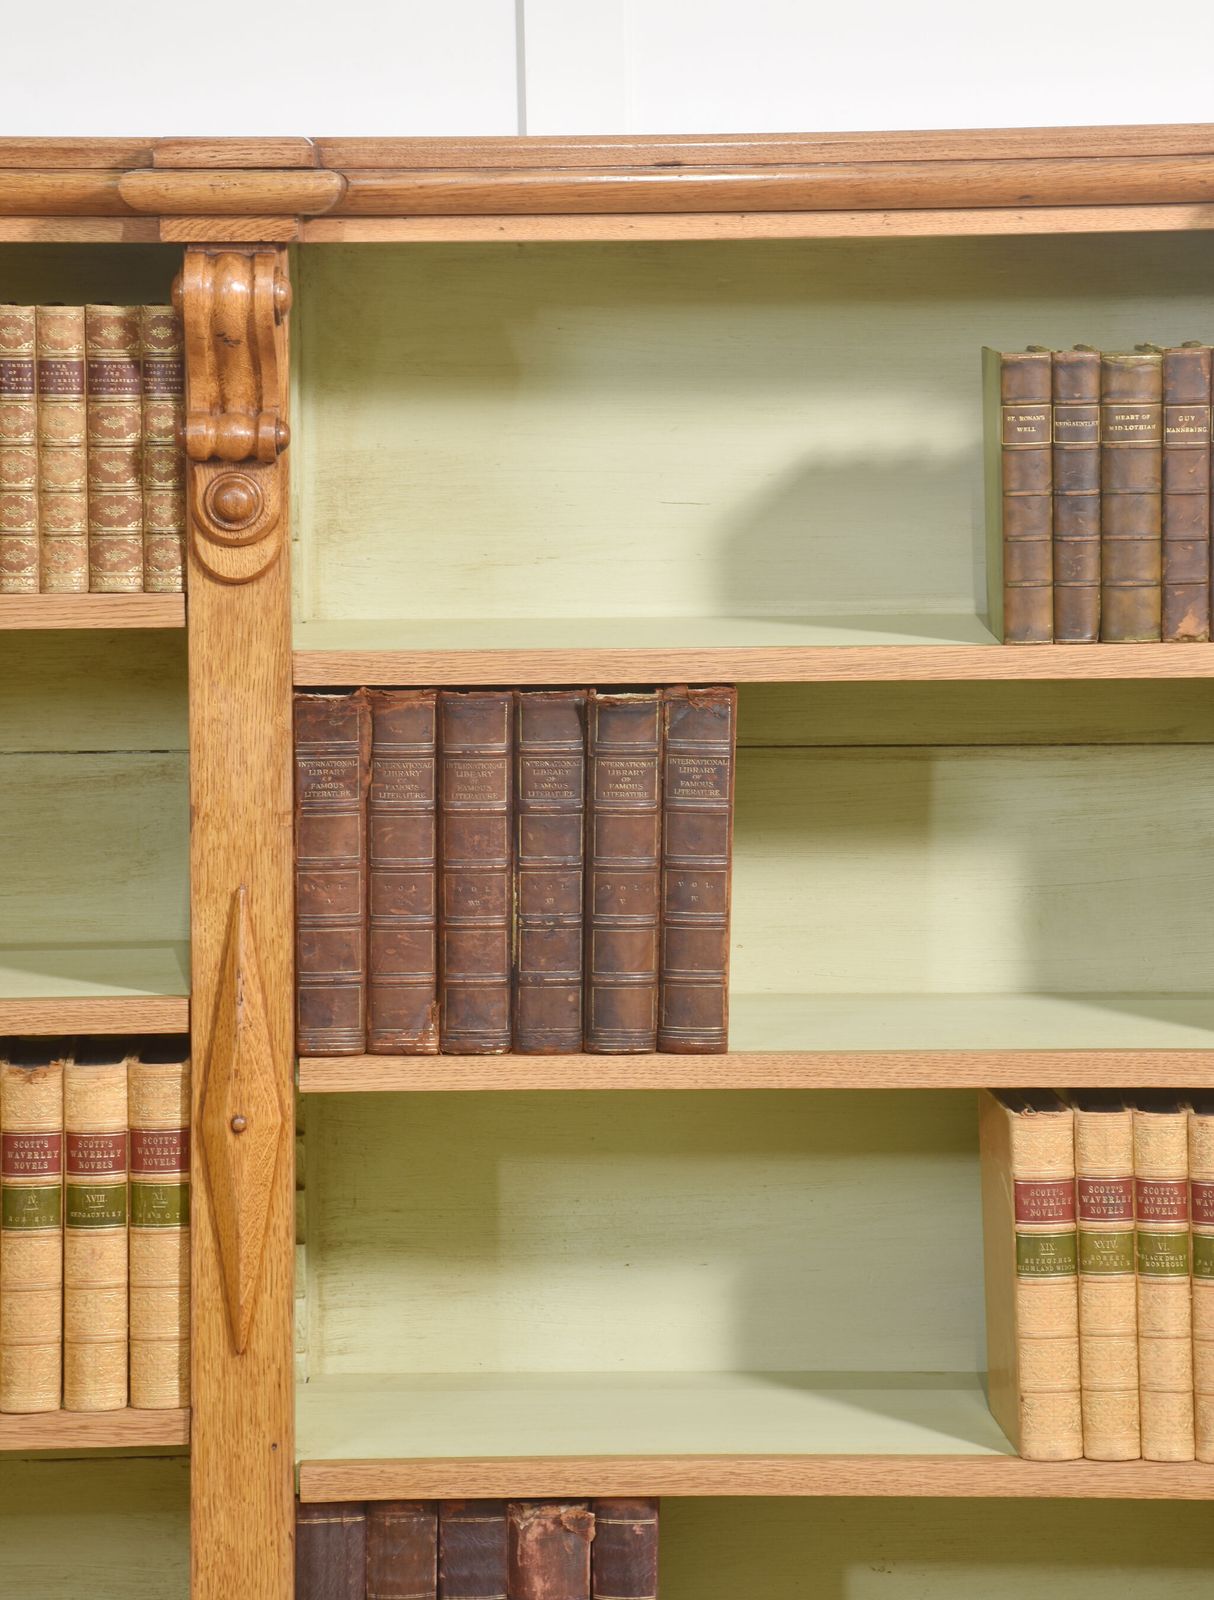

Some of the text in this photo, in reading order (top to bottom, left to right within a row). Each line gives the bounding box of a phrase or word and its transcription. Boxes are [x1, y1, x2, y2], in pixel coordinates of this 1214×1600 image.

[14, 1140, 49, 1148] SCOTT'S
[78, 1140, 113, 1148] SCOTT'S
[143, 1136, 178, 1144] SCOTT'S
[8, 1150, 59, 1159] WAVERLEY
[70, 1150, 122, 1158] WAVERLEY
[14, 1162, 48, 1170] NOVELS
[78, 1160, 113, 1169] NOVELS
[143, 1158, 177, 1166] NOVELS
[1030, 1188, 1064, 1196] SCOTT'S
[1088, 1186, 1124, 1194] SCOTT'S
[1143, 1186, 1180, 1195] SCOTT'S
[1023, 1197, 1072, 1206] WAVERLEY
[1082, 1195, 1132, 1204] WAVERLEY
[1138, 1196, 1187, 1204] WAVERLEY
[1030, 1208, 1063, 1217] NOVELS
[1090, 1206, 1124, 1214] NOVELS
[1144, 1206, 1178, 1215] NOVELS
